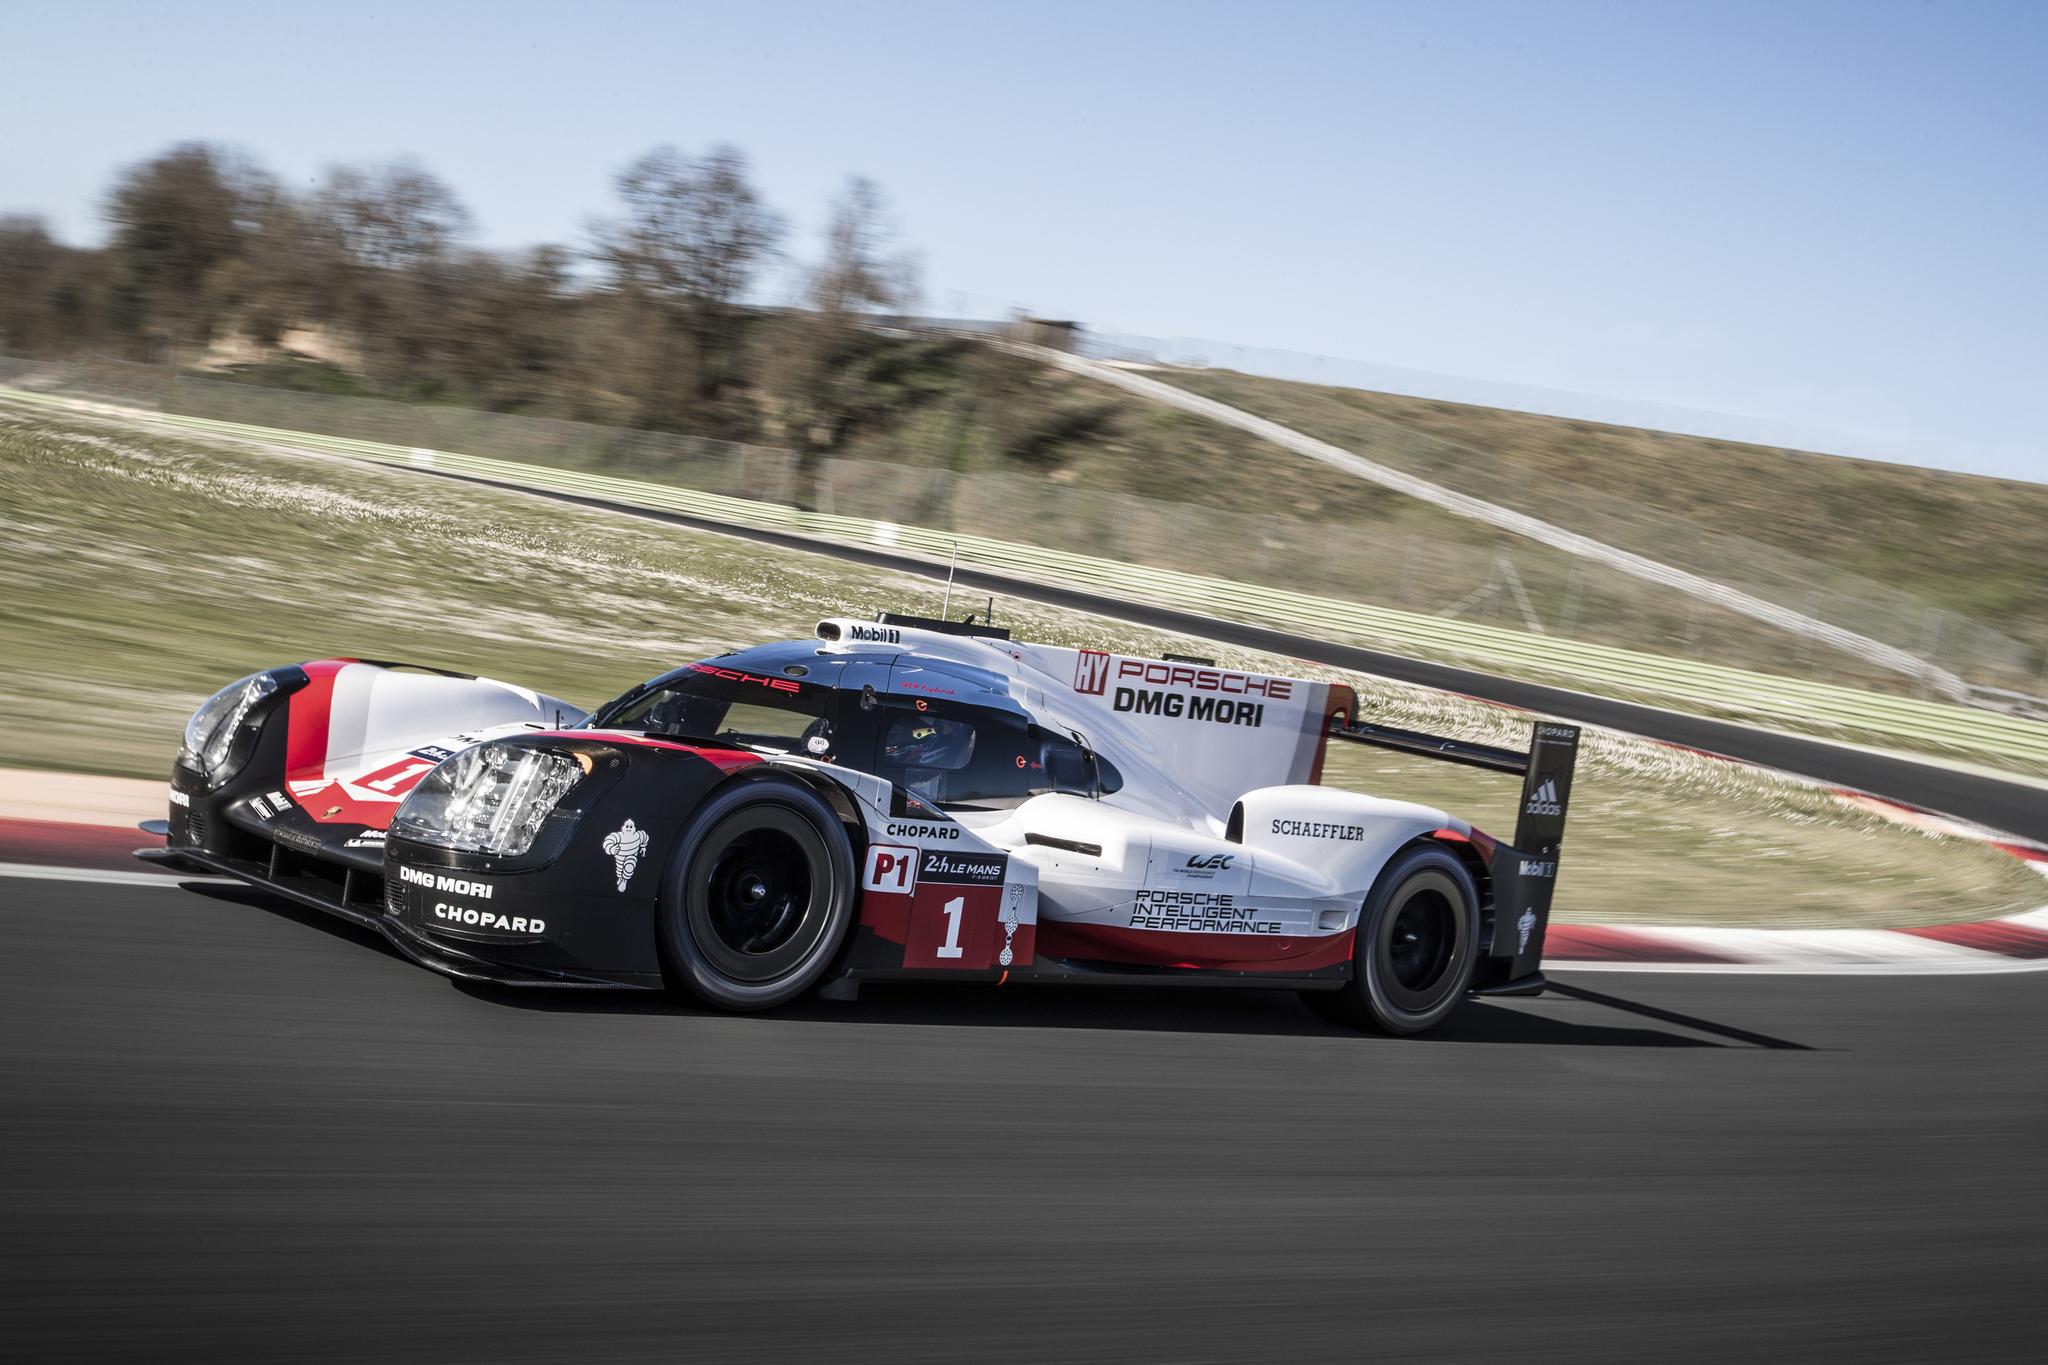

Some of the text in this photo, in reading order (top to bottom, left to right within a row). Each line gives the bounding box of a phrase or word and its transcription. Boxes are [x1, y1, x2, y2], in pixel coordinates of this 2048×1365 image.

[852, 626, 900, 643] Mobil 1
[1077, 652, 1108, 692] HY
[1118, 661, 1293, 700] PORSCHE
[1113, 686, 1264, 727] DMG MORI
[367, 763, 437, 792] 1
[1526, 801, 1562, 816] adidas
[887, 824, 960, 839] CHOPARD
[1272, 819, 1365, 841] SCHAEFFLER
[872, 853, 910, 887] P1
[950, 863, 966, 874] LE
[966, 864, 1001, 876] MANS
[1186, 854, 1235, 870] WEC
[1519, 860, 1545, 876] Mobil
[400, 865, 494, 899] DMG MORI
[1136, 890, 1234, 906] PORSCHE
[434, 903, 546, 934] CHOPARD
[1132, 903, 1258, 920] INTELLIGENT
[936, 896, 965, 959] 1
[1129, 916, 1282, 934] PERFORMANCE
